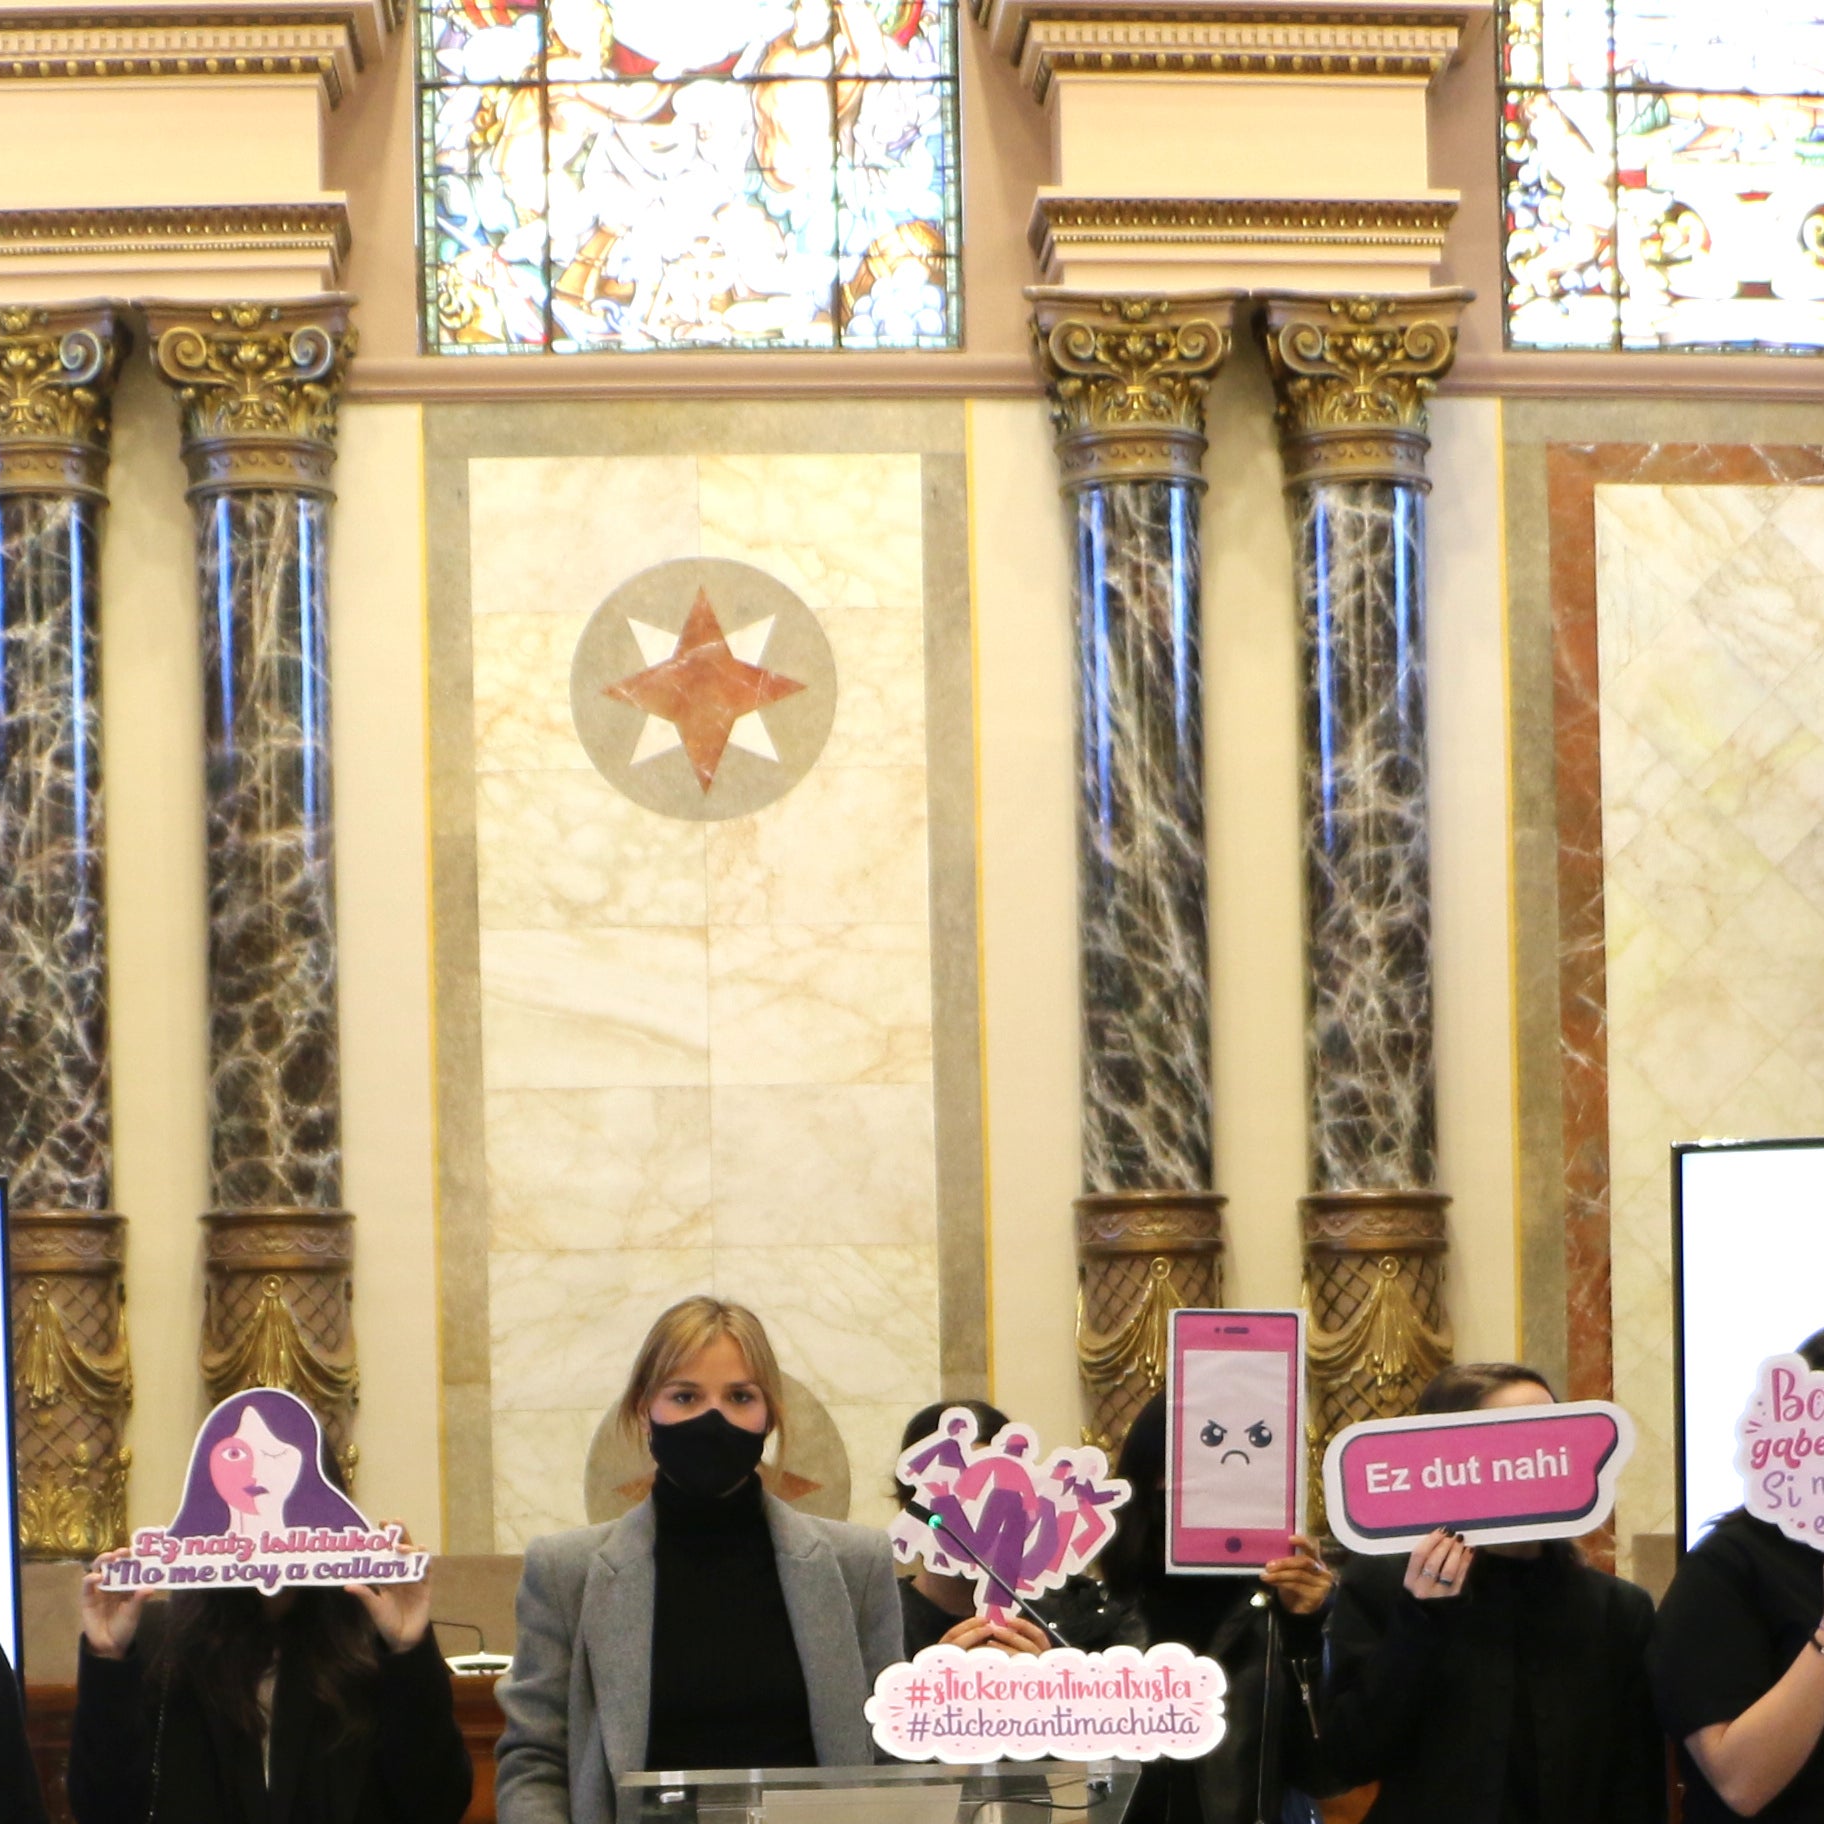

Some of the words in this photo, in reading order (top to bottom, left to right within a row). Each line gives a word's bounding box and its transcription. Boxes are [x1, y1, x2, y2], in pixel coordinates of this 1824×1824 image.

[1365, 1461, 1413, 1494] Ez
[1421, 1457, 1482, 1490] dut
[1491, 1447, 1569, 1482] nahi
[1762, 1470, 1802, 1510] Si
[135, 1531, 183, 1564] Ez
[260, 1528, 399, 1554] isilduko!
[168, 1564, 219, 1584] me
[222, 1563, 280, 1589] voy
[285, 1561, 308, 1580] a
[906, 1665, 1193, 1708] #stickerantimatxista
[906, 1703, 1201, 1742] #stickerantimachista
